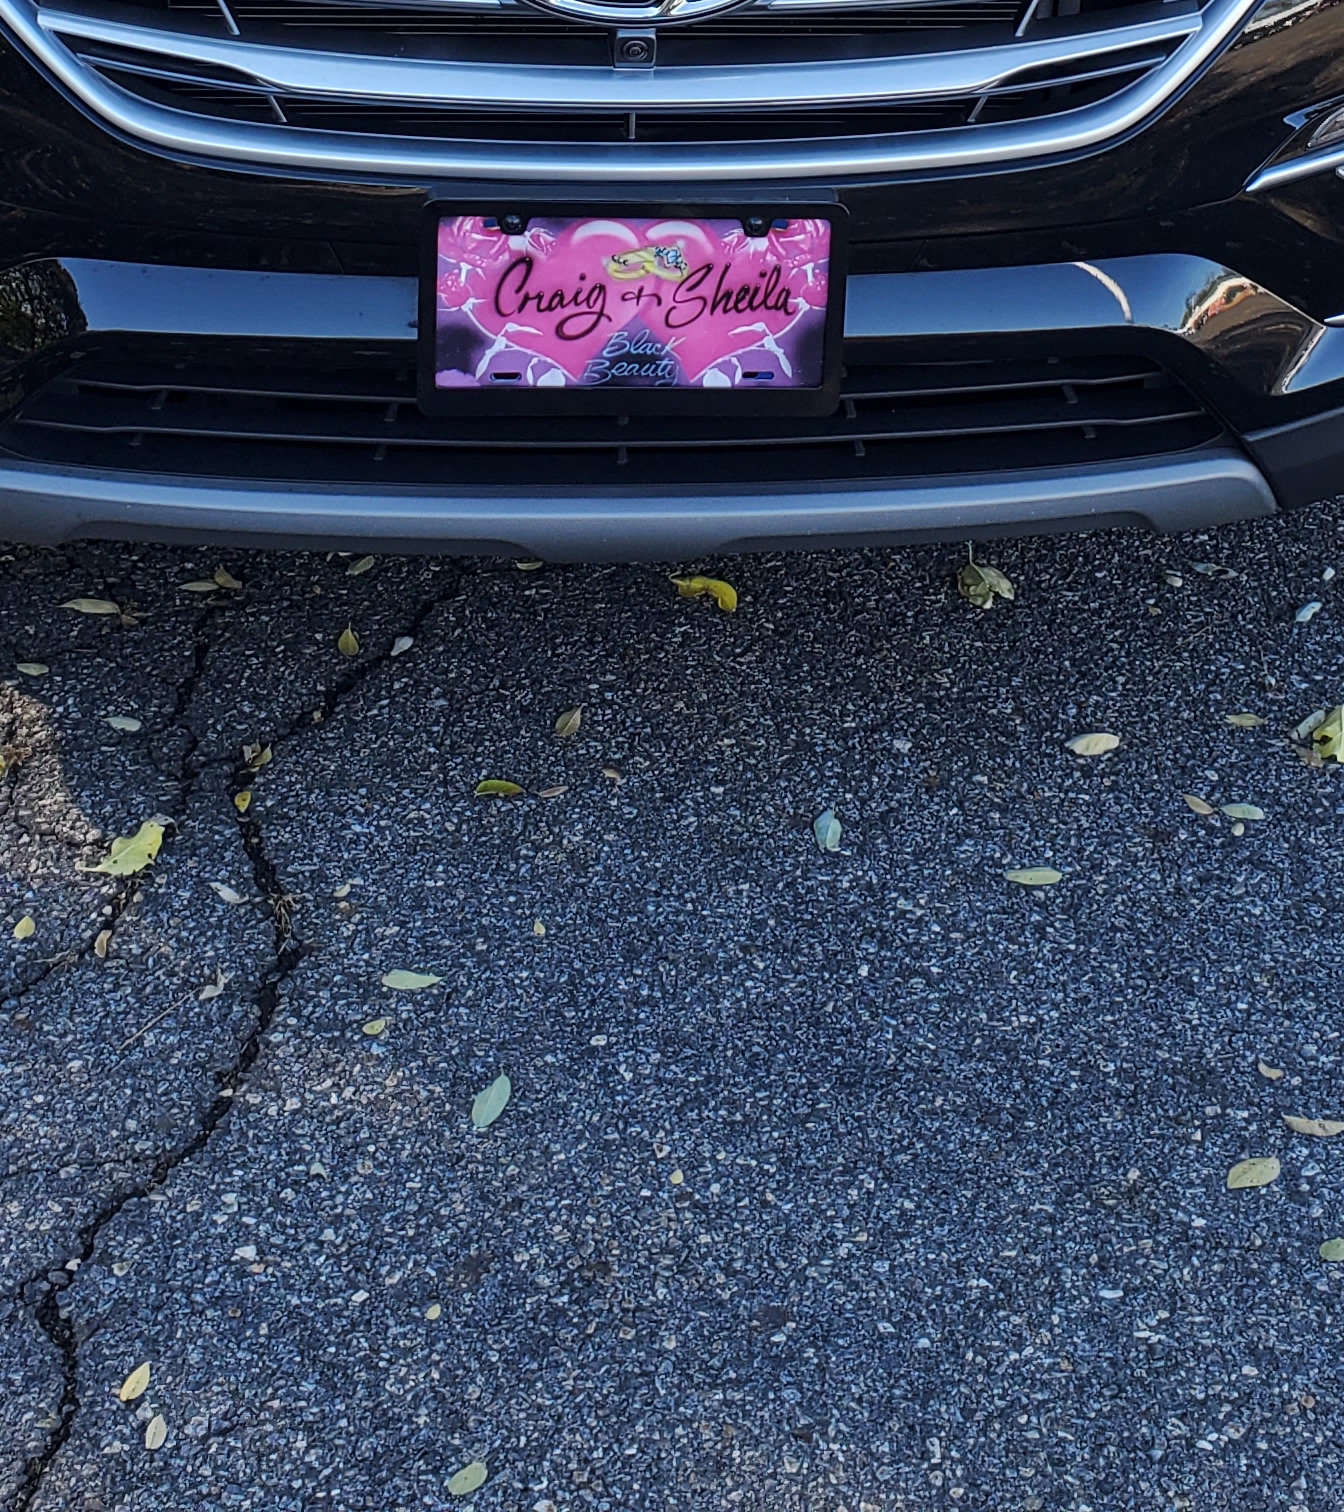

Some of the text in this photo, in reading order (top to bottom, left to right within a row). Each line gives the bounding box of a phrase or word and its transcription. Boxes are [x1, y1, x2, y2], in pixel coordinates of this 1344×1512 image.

[494, 256, 613, 341] Craig
[664, 263, 797, 329] Sheila
[576, 358, 680, 387] Beauty
